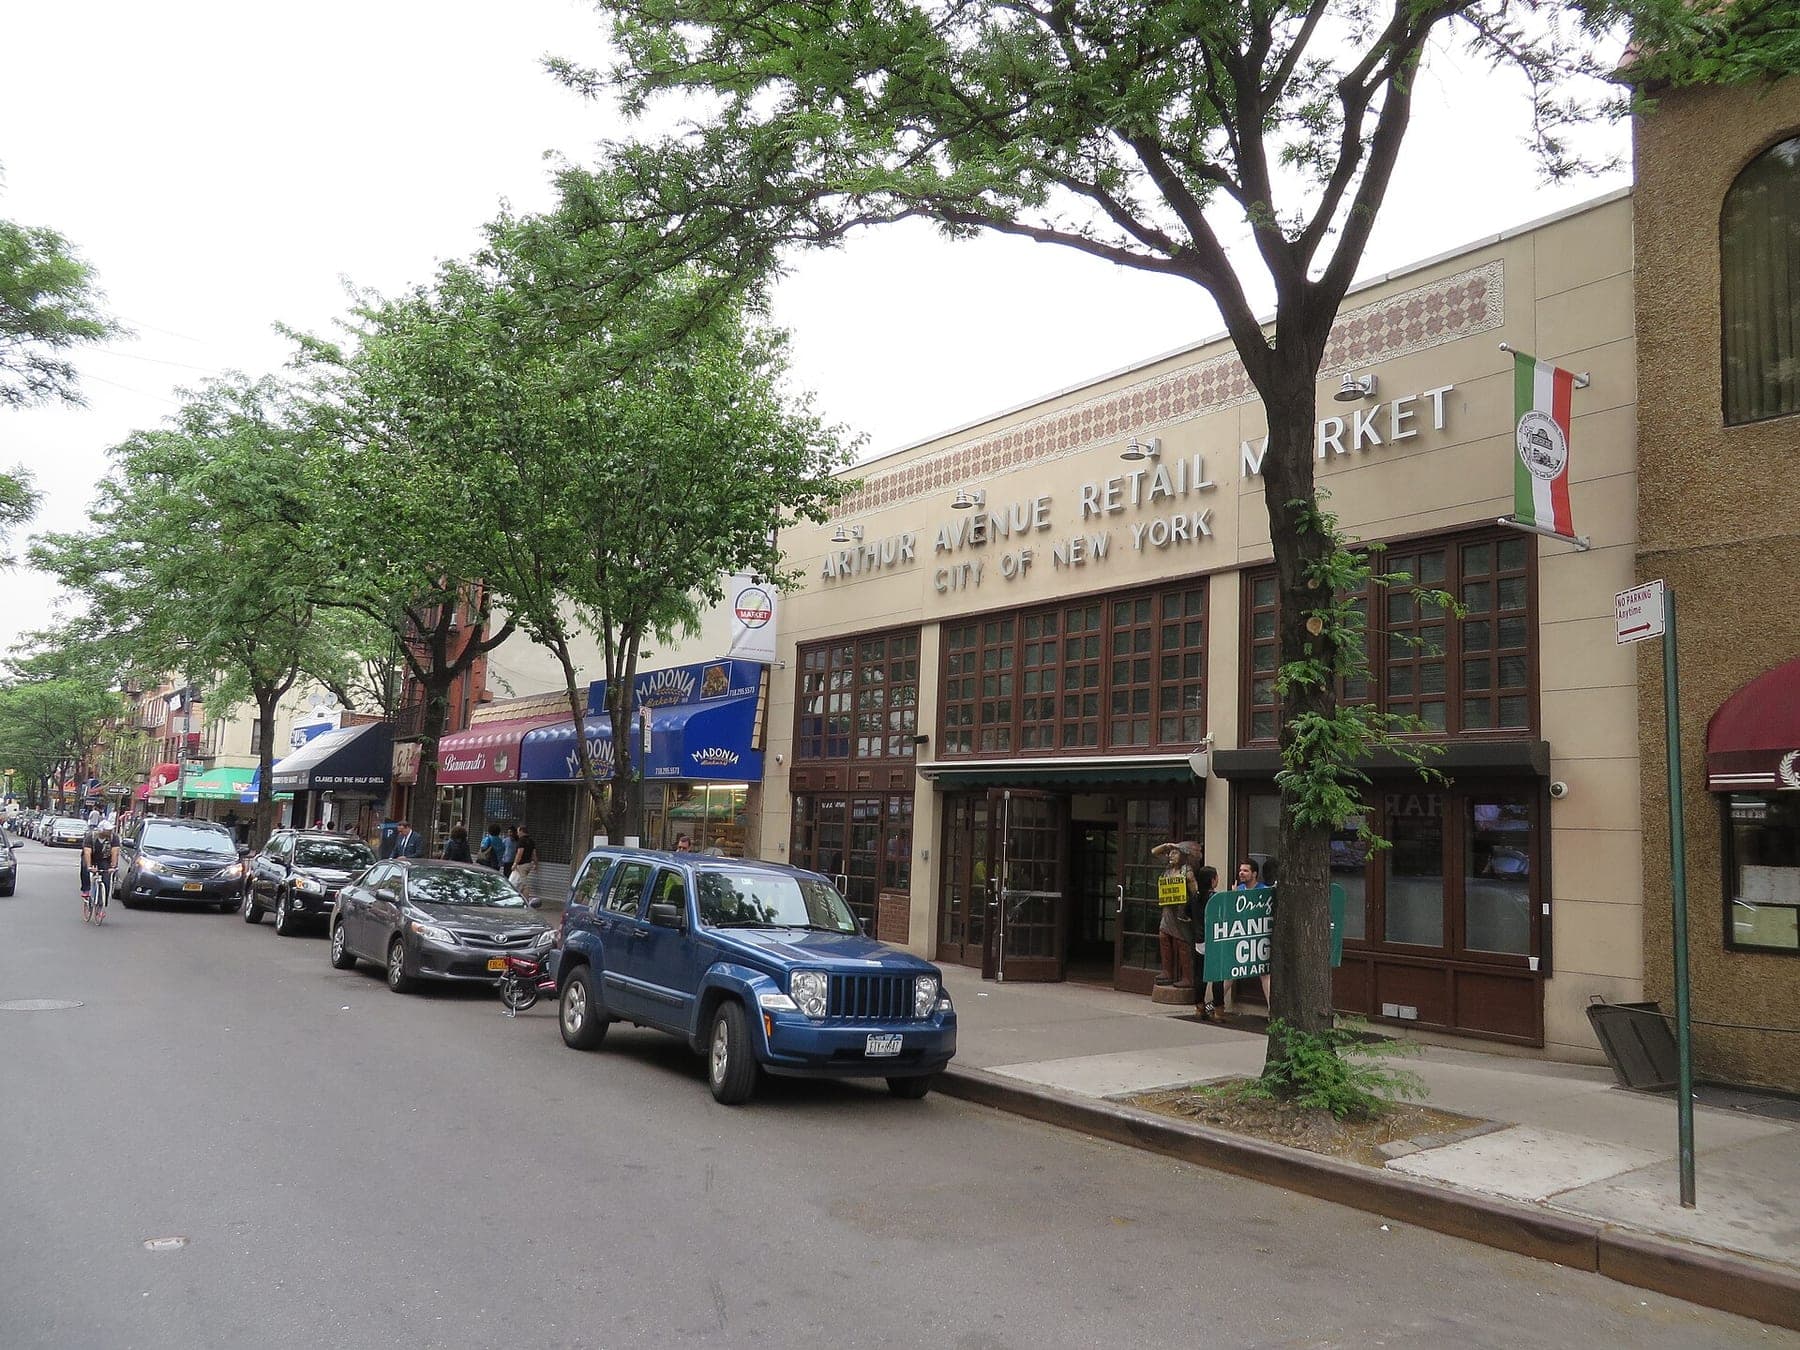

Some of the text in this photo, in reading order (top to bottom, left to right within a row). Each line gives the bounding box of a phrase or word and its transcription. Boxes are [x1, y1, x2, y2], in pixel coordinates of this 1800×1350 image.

[822, 531, 915, 579] ARTHUR
[934, 496, 1051, 552] AVENUE
[1081, 453, 1215, 518] RETAIL
[1241, 384, 1454, 477] MRKET
[934, 509, 1214, 593] CITY OF NEW YORK
[1617, 590, 1652, 608] NO PARKING
[1618, 606, 1641, 619] Anytime
[636, 669, 696, 704] MADONIA
[443, 752, 486, 772] Biancardi's
[566, 738, 615, 772] MDONI
[691, 747, 740, 765] MADONIA
[315, 775, 333, 783] CLAMS
[354, 776, 367, 784] HALF
[368, 776, 385, 784] SHELL
[1231, 966, 1247, 977] ON
